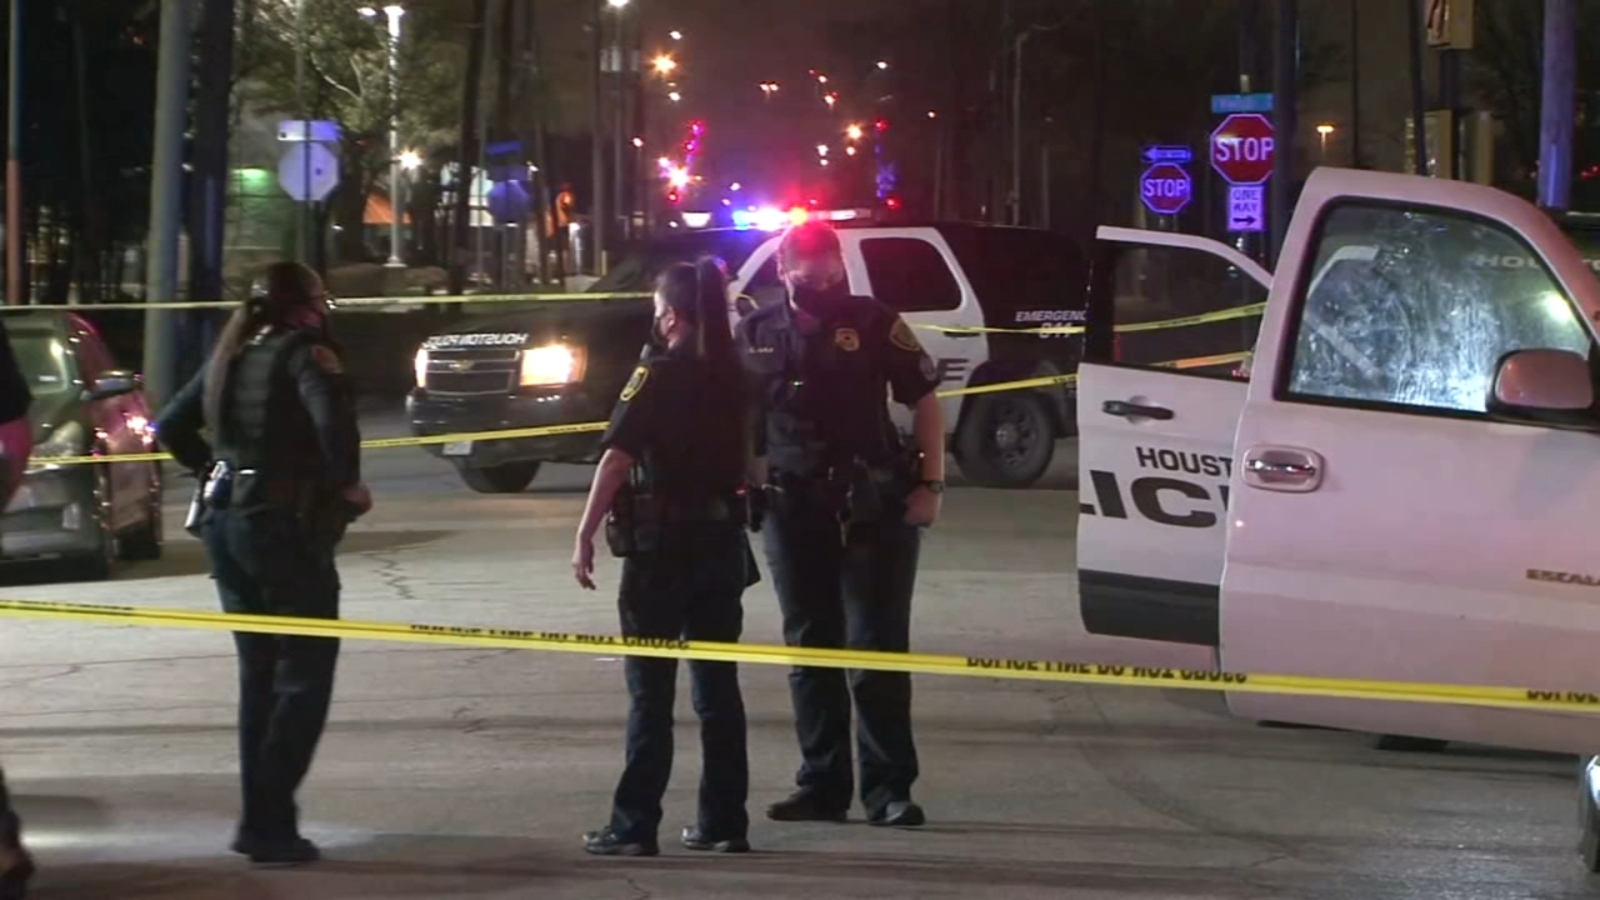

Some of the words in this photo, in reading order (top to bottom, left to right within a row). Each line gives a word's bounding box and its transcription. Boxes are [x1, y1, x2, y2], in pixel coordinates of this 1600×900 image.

[1216, 137, 1274, 161] STOP
[1144, 179, 1186, 197] STOP
[1232, 189, 1259, 200] ONE
[1232, 202, 1258, 213] WAY
[1526, 569, 1600, 587] ESCAL
